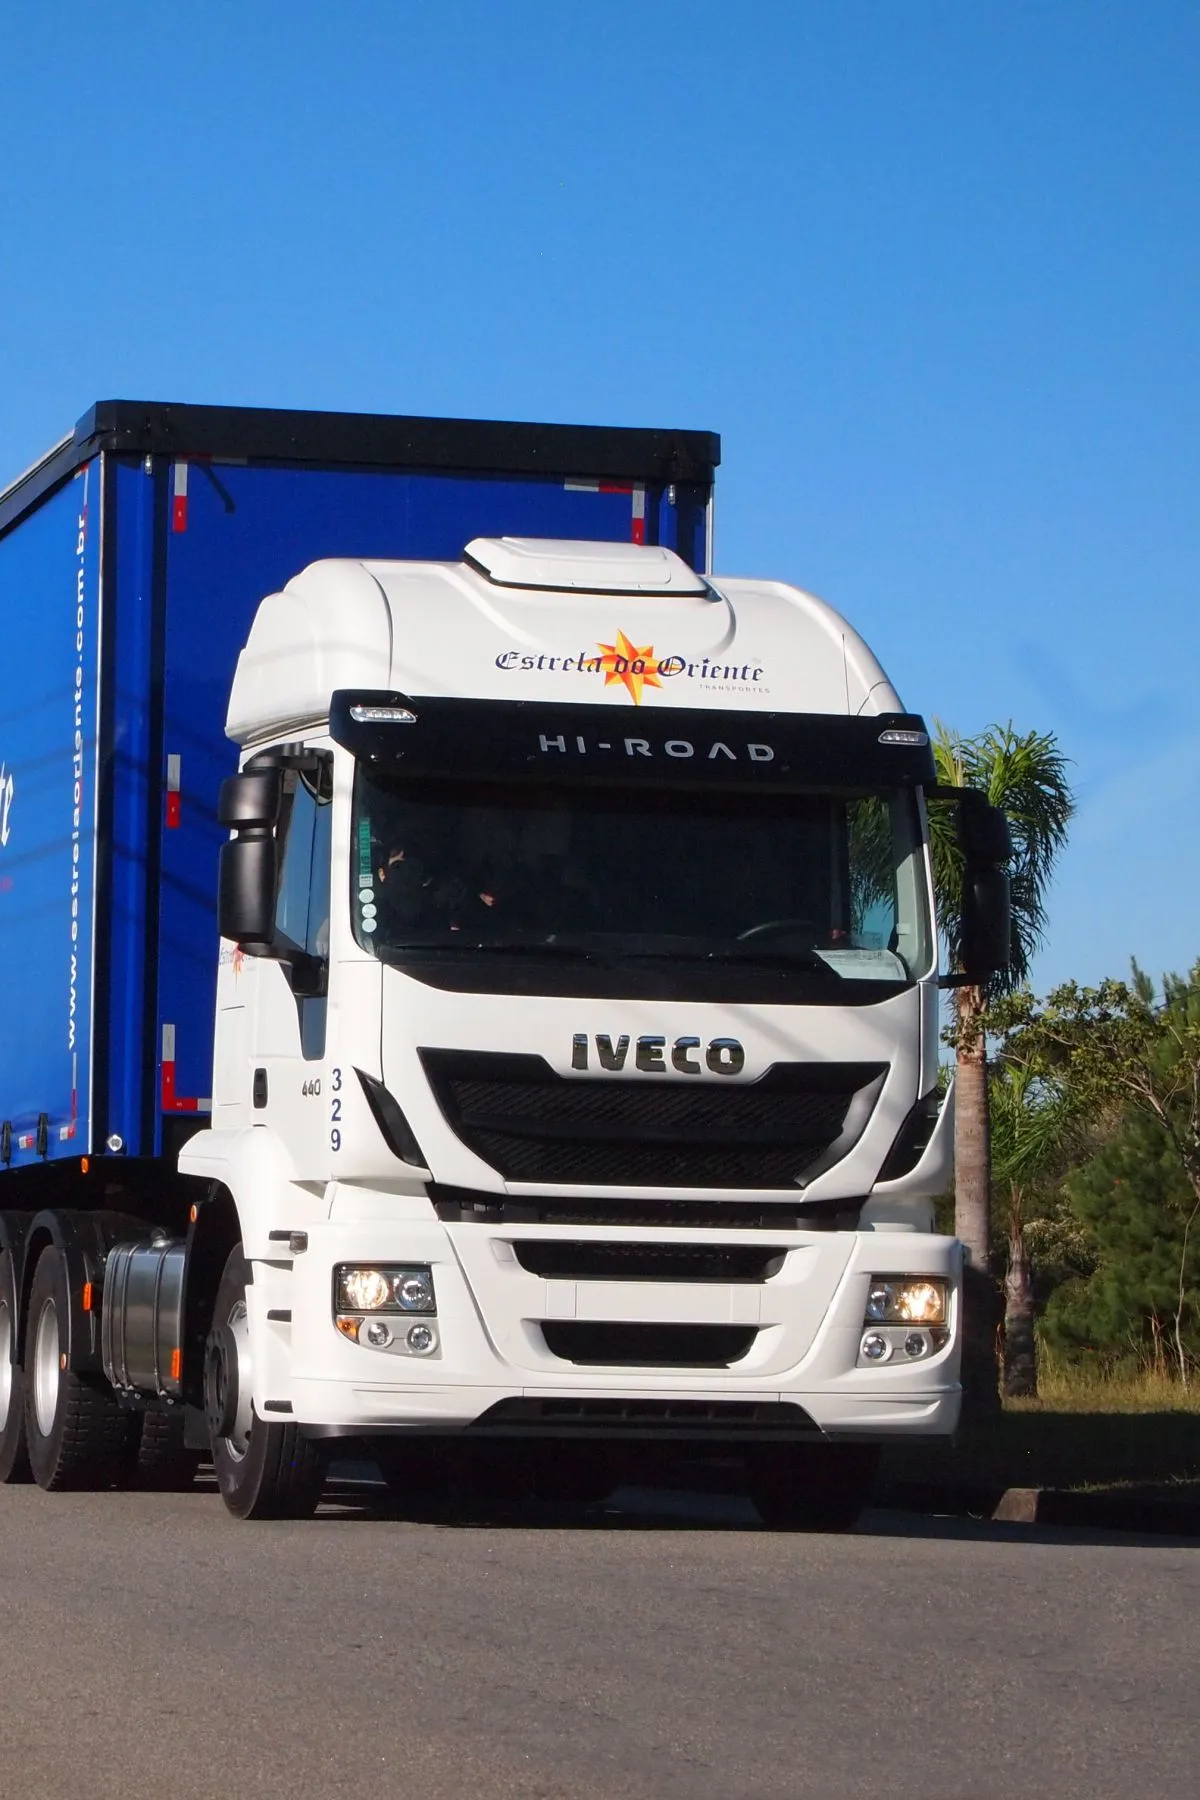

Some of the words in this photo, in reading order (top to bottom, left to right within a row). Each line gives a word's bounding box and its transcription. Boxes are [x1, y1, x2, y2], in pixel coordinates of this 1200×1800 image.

[495, 651, 602, 673] Estrela
[614, 654, 646, 675] do
[657, 655, 764, 681] Oriente
[699, 684, 771, 694] TRANSPORTES
[538, 734, 775, 762] HI-ROAD
[571, 1033, 746, 1076] IVECO
[301, 1078, 321, 1097] 440
